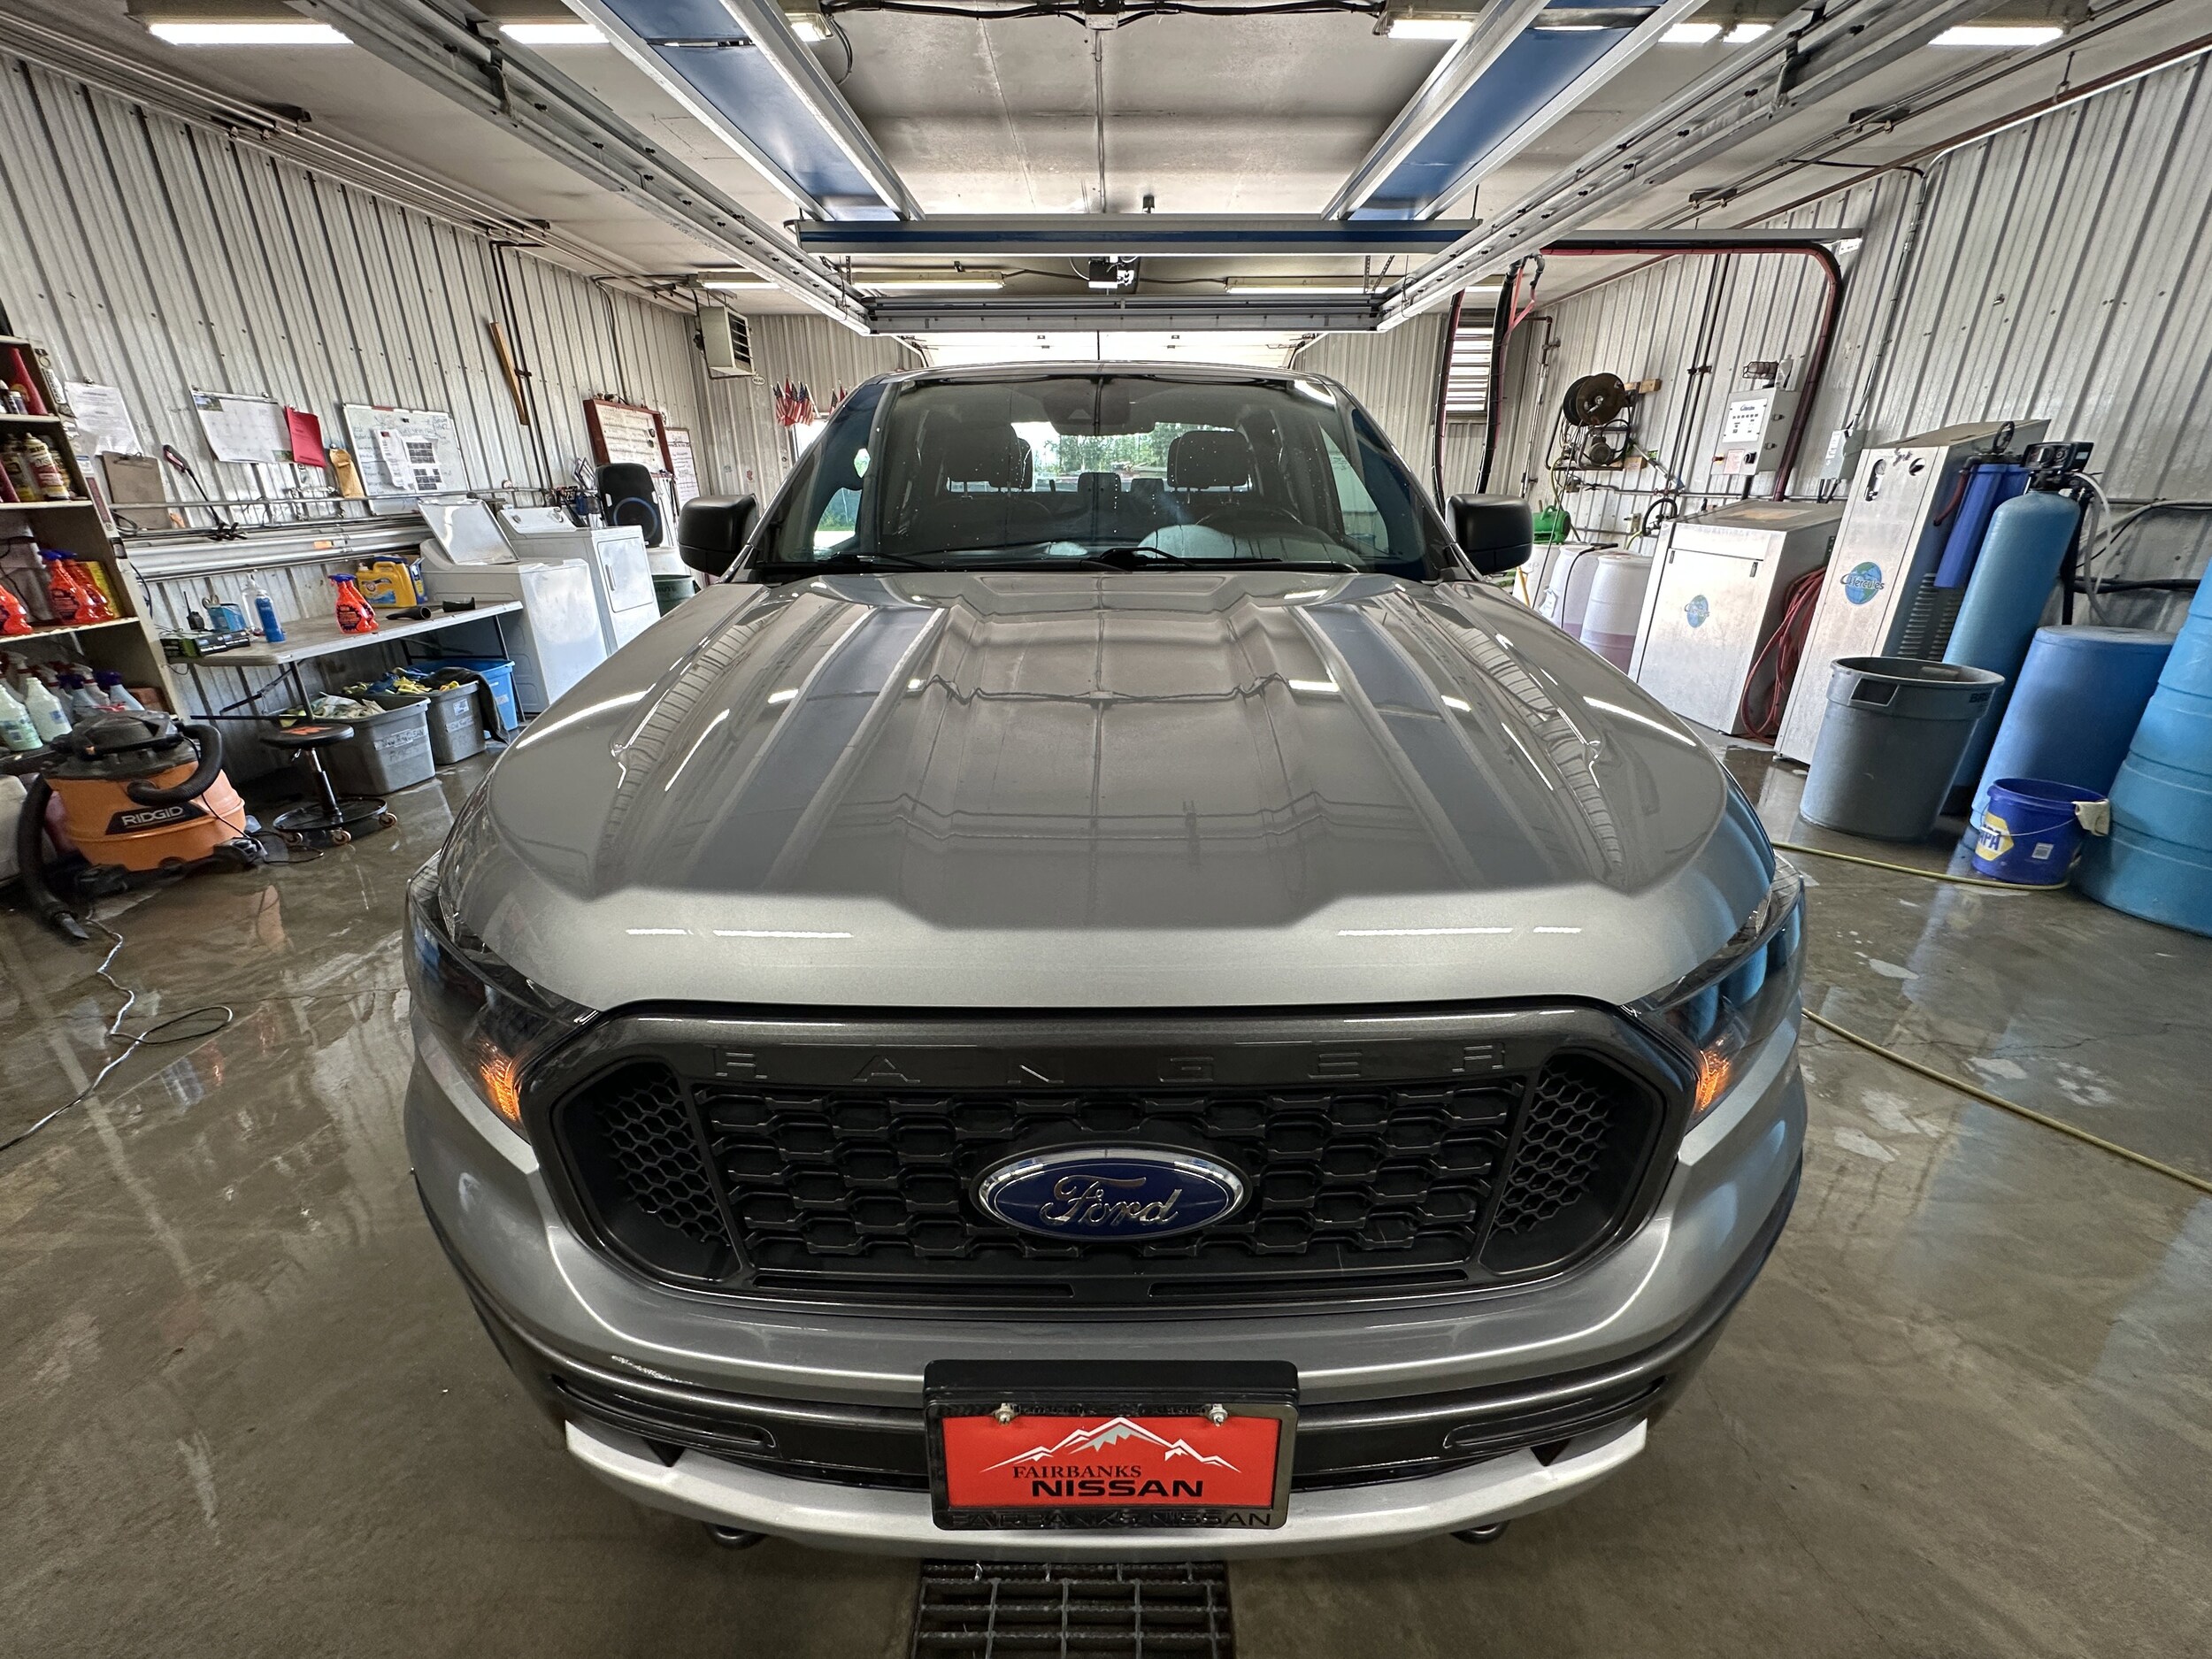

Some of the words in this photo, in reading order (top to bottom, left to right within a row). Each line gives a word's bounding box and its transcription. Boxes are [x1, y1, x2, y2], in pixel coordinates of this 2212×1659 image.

[1840, 573, 1886, 590] Hercules
[121, 806, 184, 826] RIDGID
[1978, 824, 2001, 850] APA
[713, 1041, 1507, 1084] RANGER
[1039, 1174, 1183, 1227] Ford
[1013, 1465, 1142, 1479] FAIRBANKS
[1033, 1479, 1204, 1497] NISSAN
[951, 1509, 1138, 1529] FAIRBANKS
[1150, 1510, 1271, 1529] NISSAN
